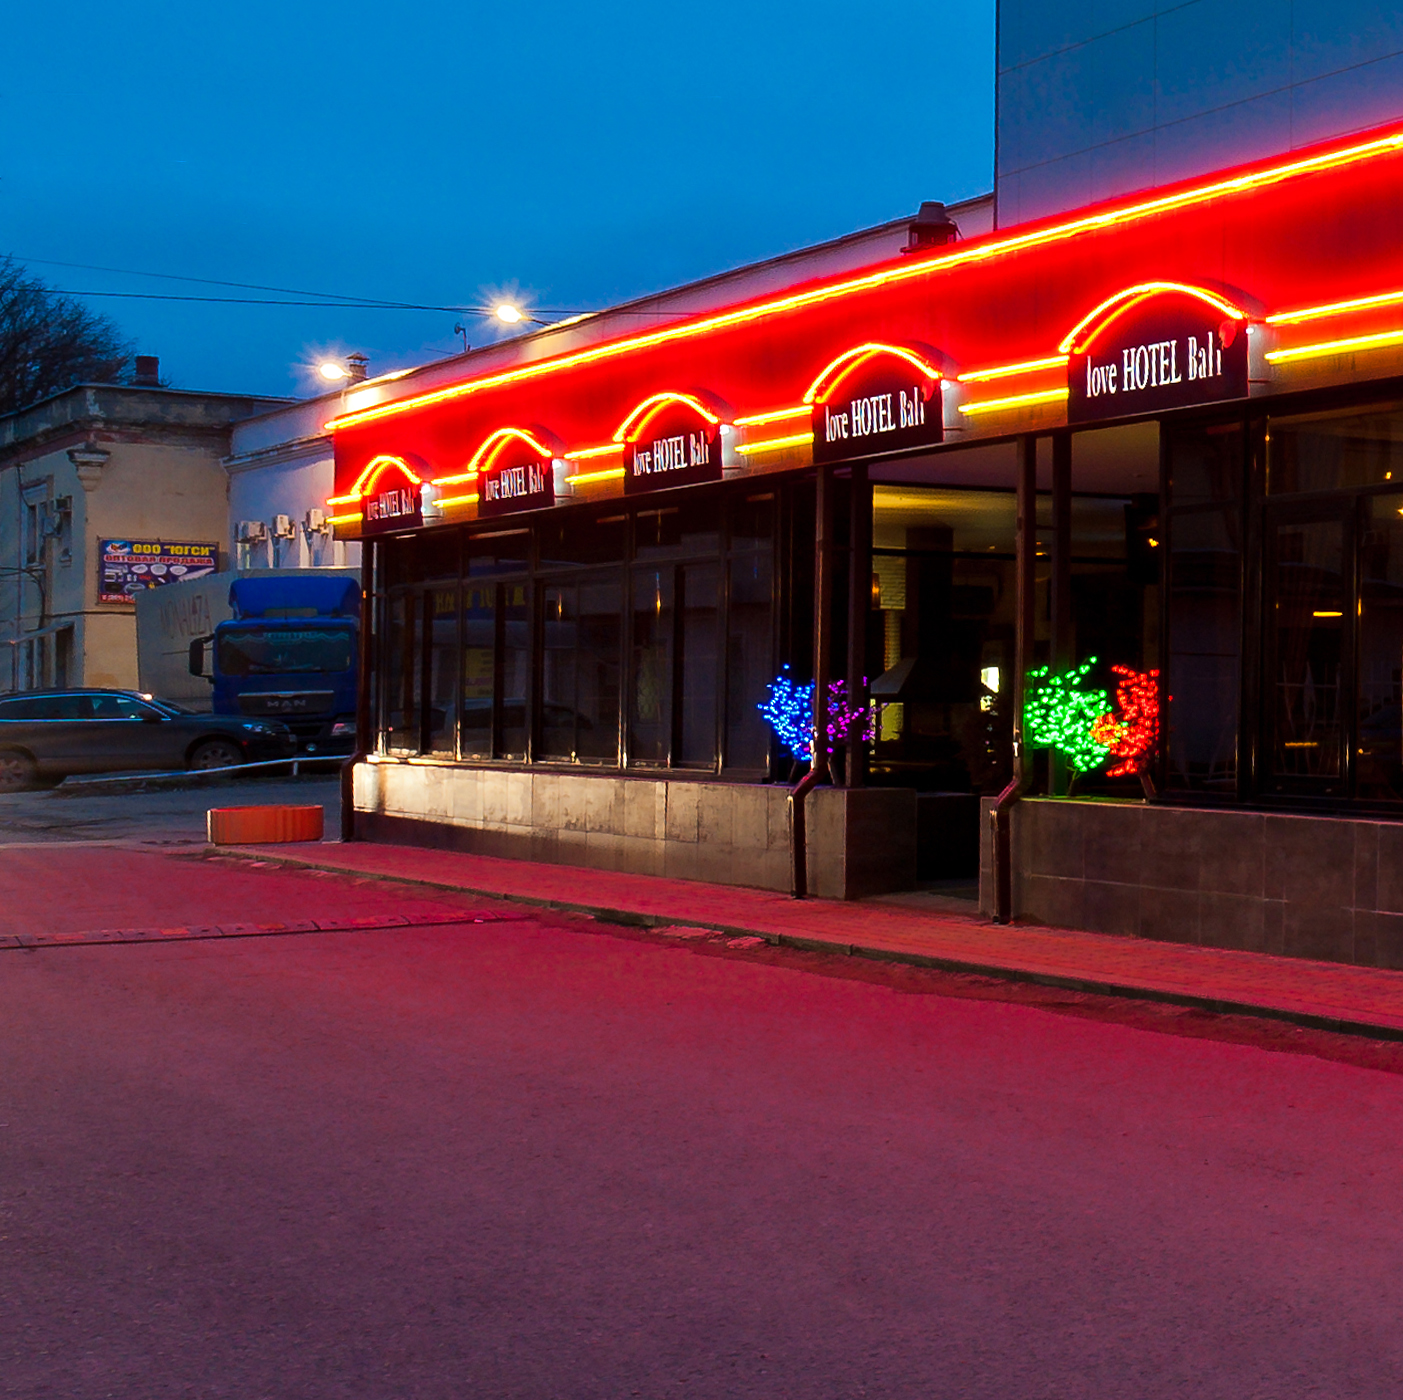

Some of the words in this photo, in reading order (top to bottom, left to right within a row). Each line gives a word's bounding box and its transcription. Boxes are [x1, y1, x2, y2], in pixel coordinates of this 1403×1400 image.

[1085, 355, 1117, 399] love
[1122, 338, 1183, 390] HOTEL
[1187, 330, 1223, 381] Bali
[825, 405, 849, 443] love
[851, 392, 896, 437] HOTEL
[899, 386, 925, 430] Bali
[633, 444, 652, 476] love
[653, 434, 688, 473] HOTEL
[690, 430, 710, 467] Bali
[500, 466, 528, 499] HOTEL
[266, 699, 306, 708] MAN
